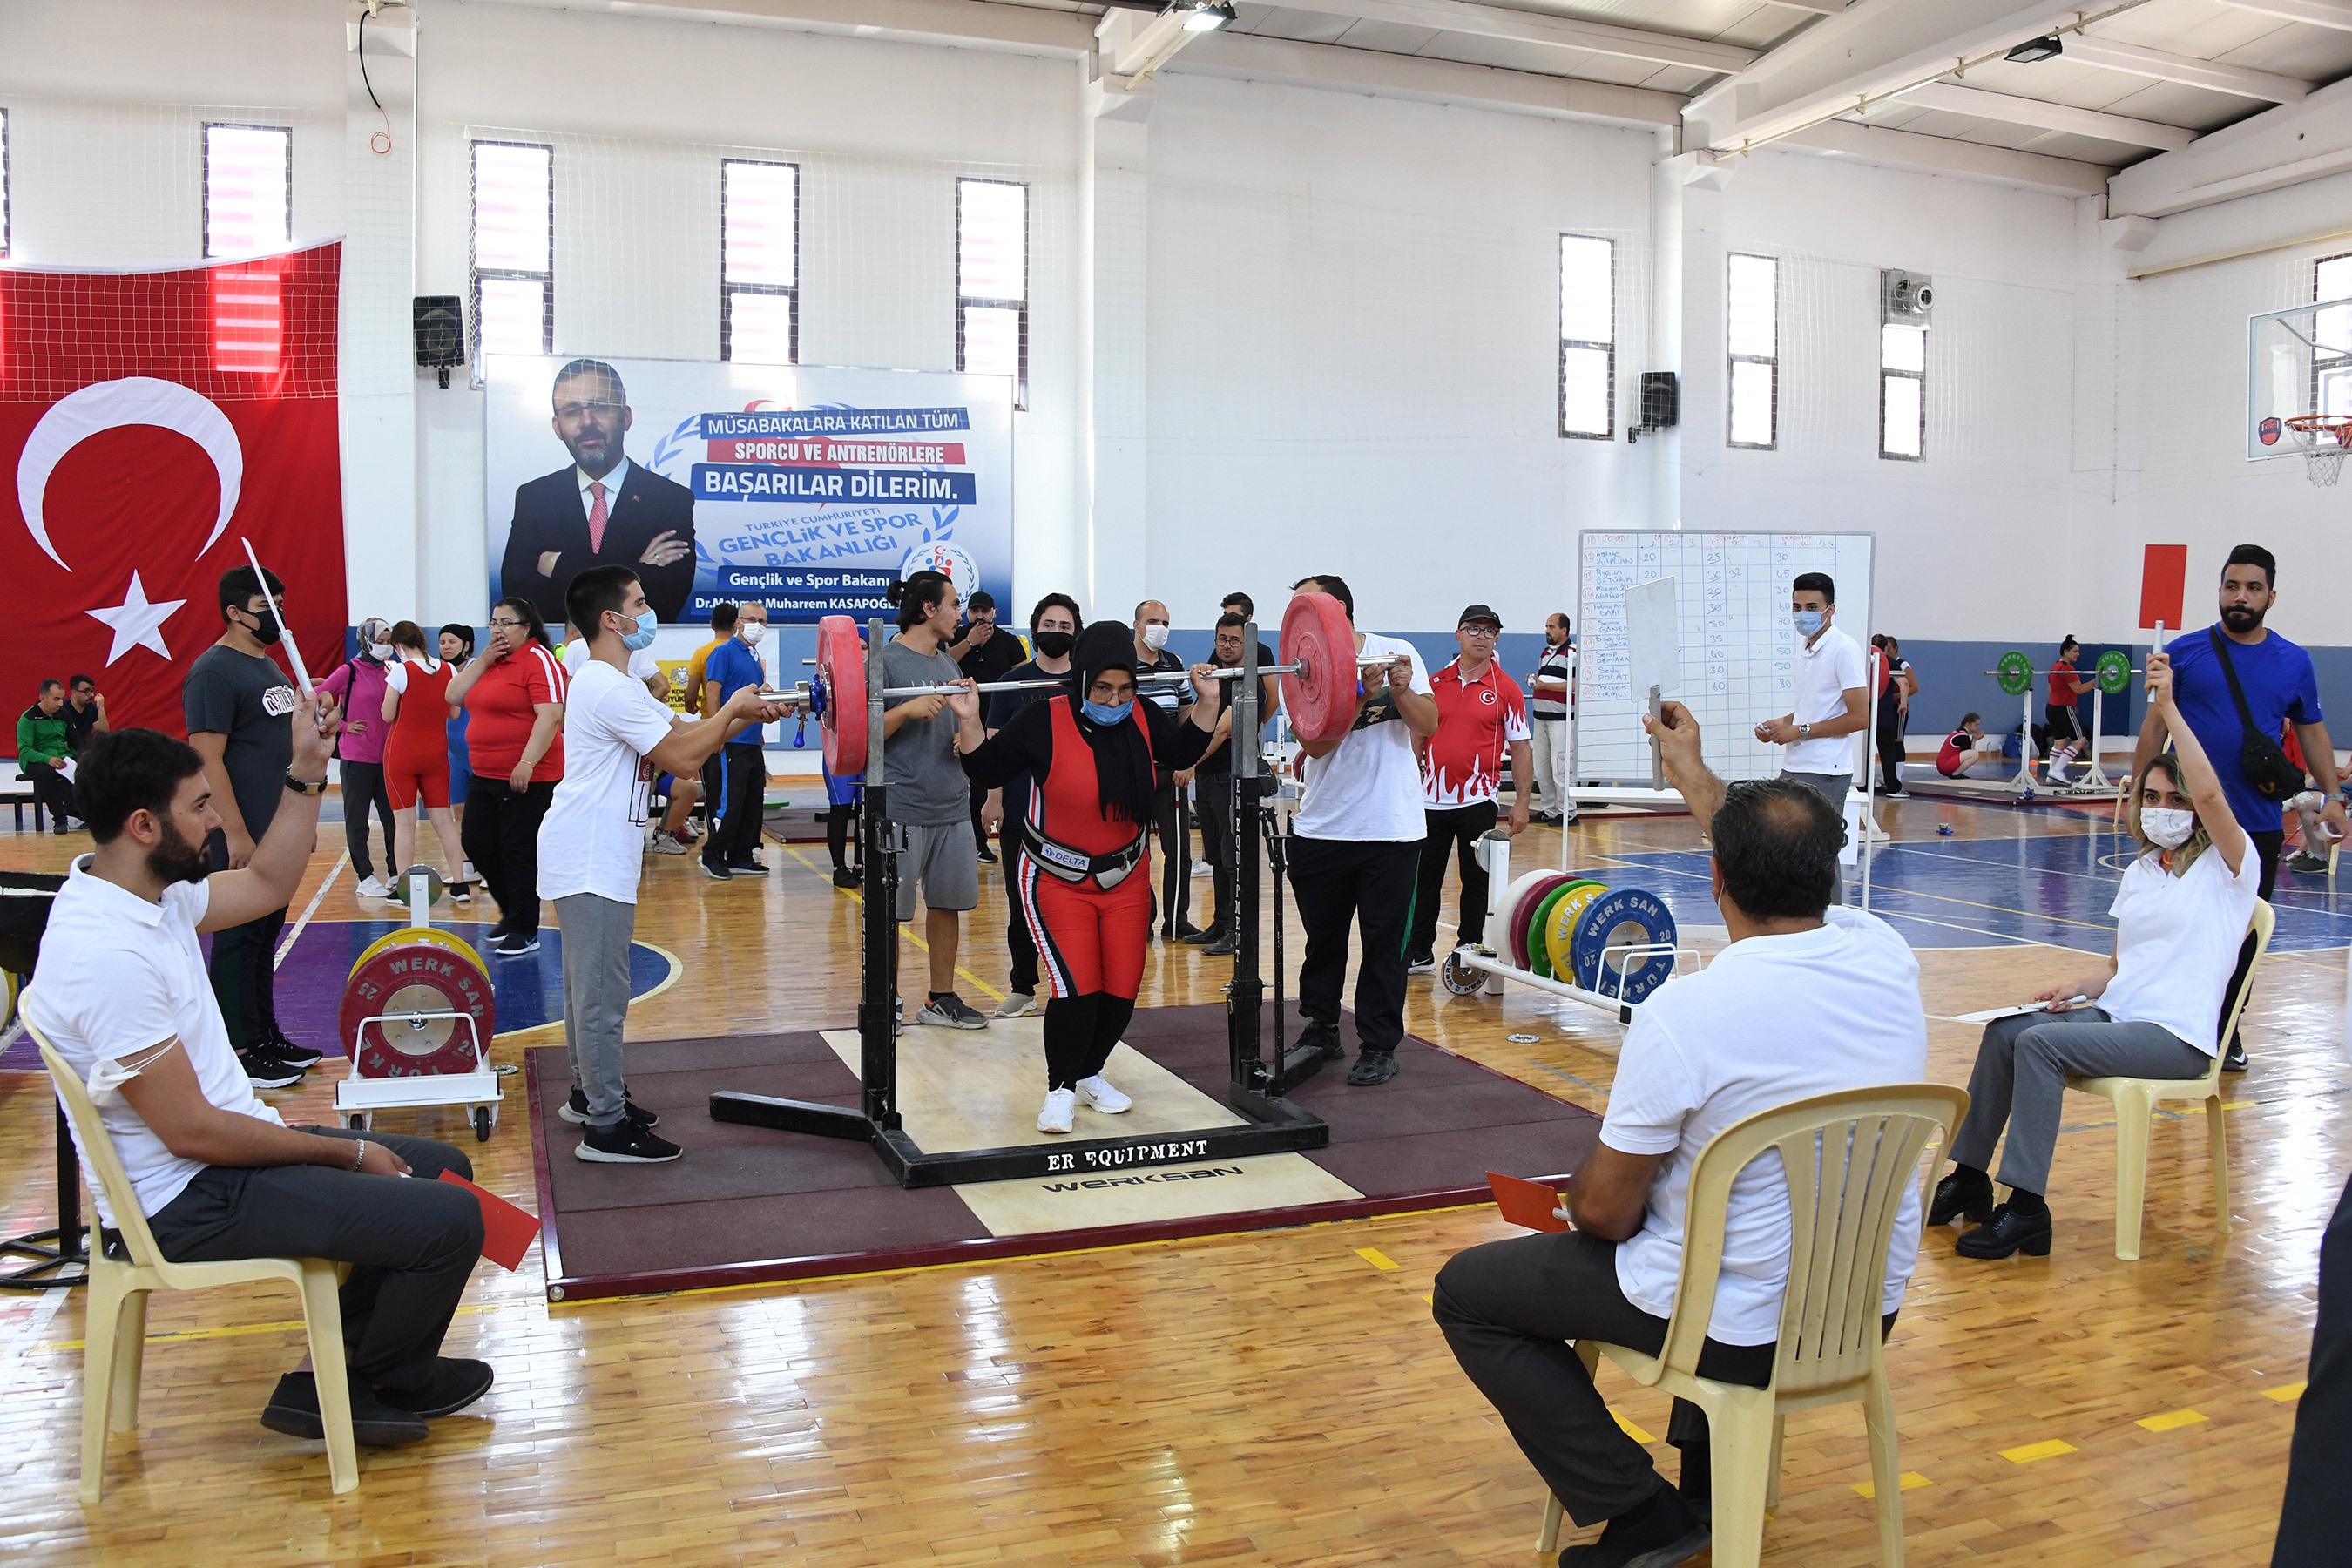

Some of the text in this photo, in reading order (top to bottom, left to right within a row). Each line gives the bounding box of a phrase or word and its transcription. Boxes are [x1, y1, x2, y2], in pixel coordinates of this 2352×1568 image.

[708, 409, 958, 434] MÜSABAKALARA KATILAN TÜM
[735, 443, 944, 463] SPORCU VE ANTRENÖRLERE
[705, 470, 958, 502] BAŞARILAR DİLERİM.
[827, 521, 859, 537] VE
[861, 513, 923, 533] SPOR
[764, 534, 898, 567] BAKANLIĞI
[1644, 552, 1656, 562] 20
[1707, 552, 1722, 562] 25
[1776, 552, 1788, 562] 30
[1644, 571, 1657, 579] 20
[1707, 570, 1722, 580] 30
[1729, 567, 1742, 578] 32
[1776, 569, 1790, 578] 45
[729, 572, 889, 590] Gençlik ve Spor Bakanı
[1774, 585, 1790, 594] 30
[765, 598, 827, 609] Muharrem
[1779, 601, 1791, 611] 60
[1777, 617, 1791, 625] 70
[1711, 650, 1724, 659] 40
[1709, 666, 1725, 674] 30
[1713, 682, 1726, 691] 60
[1779, 679, 1792, 688] 80
[1055, 852, 1086, 868] DELTA
[1558, 898, 1583, 940] WERK
[1587, 897, 1659, 937] WERK SAN
[1659, 929, 1672, 943] 20
[1584, 955, 1596, 967] 20
[358, 983, 378, 1001] 25
[389, 957, 484, 1017] WERK SAN
[458, 1040, 476, 1057] 25
[1048, 1140, 1207, 1171] ER EQUIPMENT
